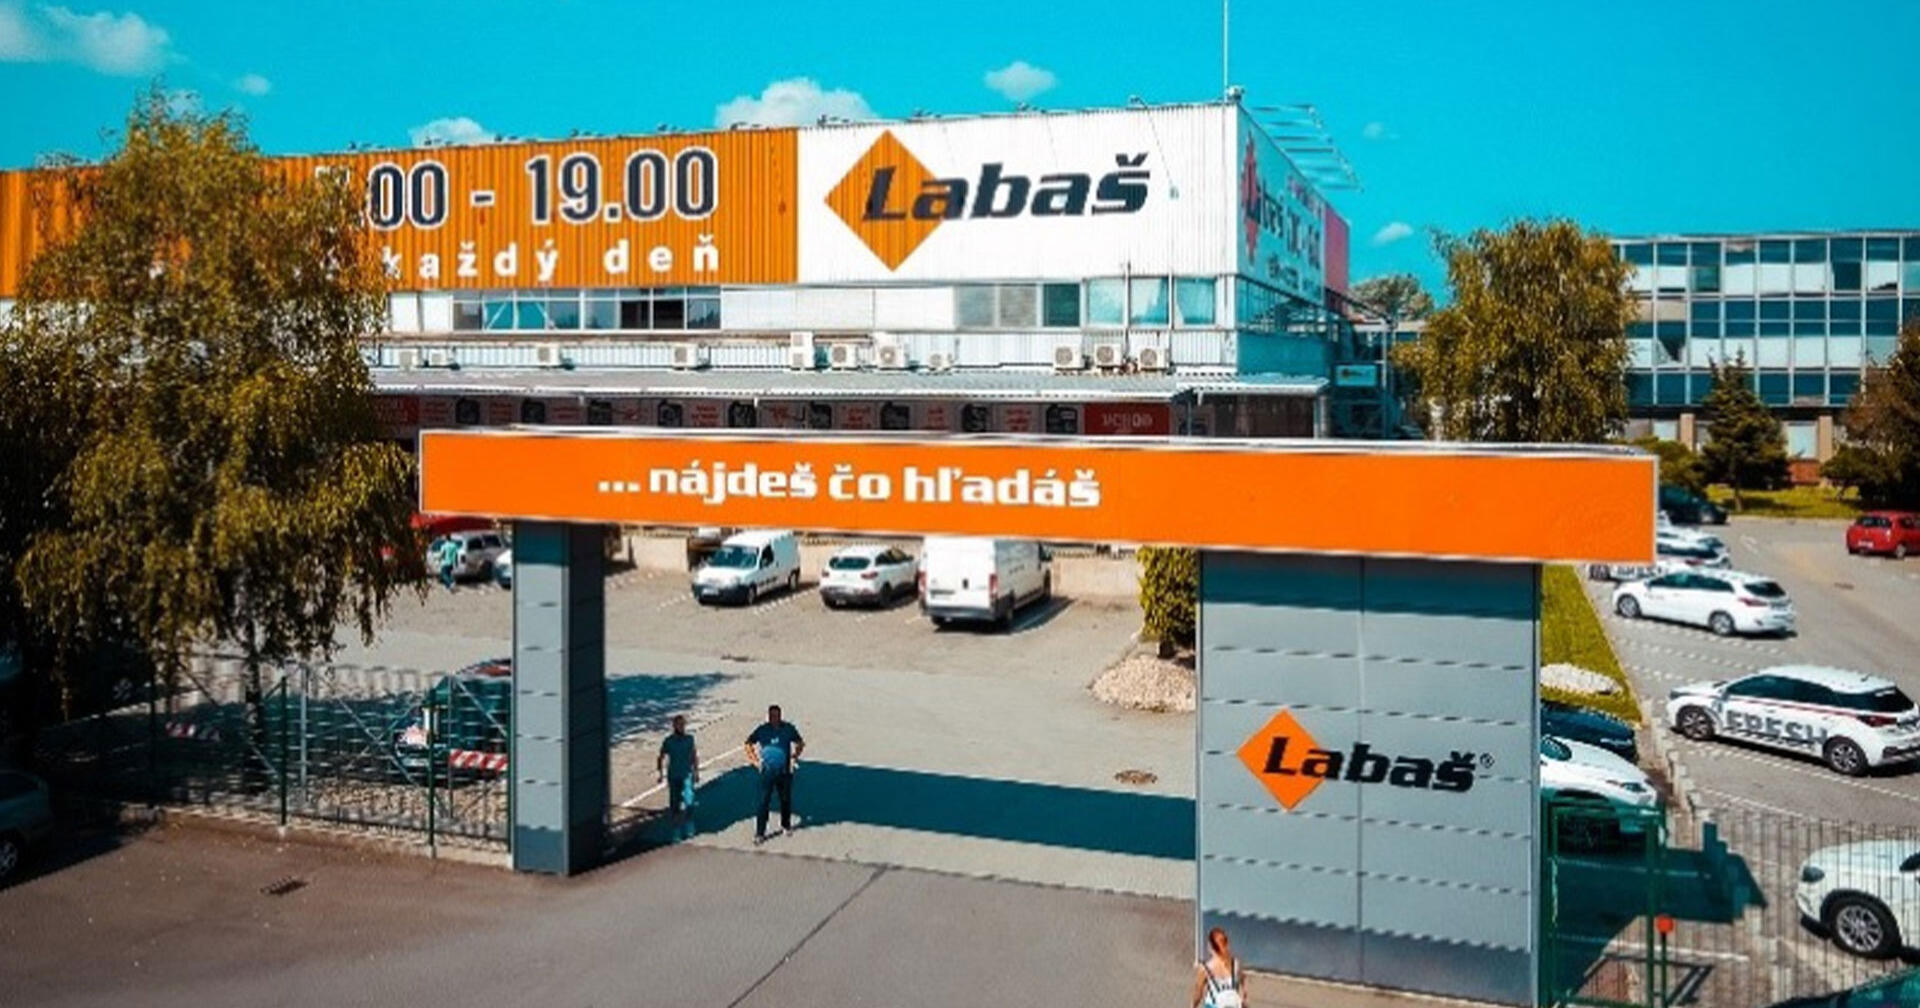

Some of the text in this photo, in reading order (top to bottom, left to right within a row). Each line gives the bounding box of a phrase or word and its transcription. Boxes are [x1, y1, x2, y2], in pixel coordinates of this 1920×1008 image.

[315, 159, 448, 231] .00
[526, 146, 719, 225] 19.00
[864, 152, 1150, 222] Labaš
[604, 236, 719, 275] deň
[828, 463, 891, 501] čo
[904, 466, 1101, 508] hľadáš
[1726, 710, 1828, 745] FRESH
